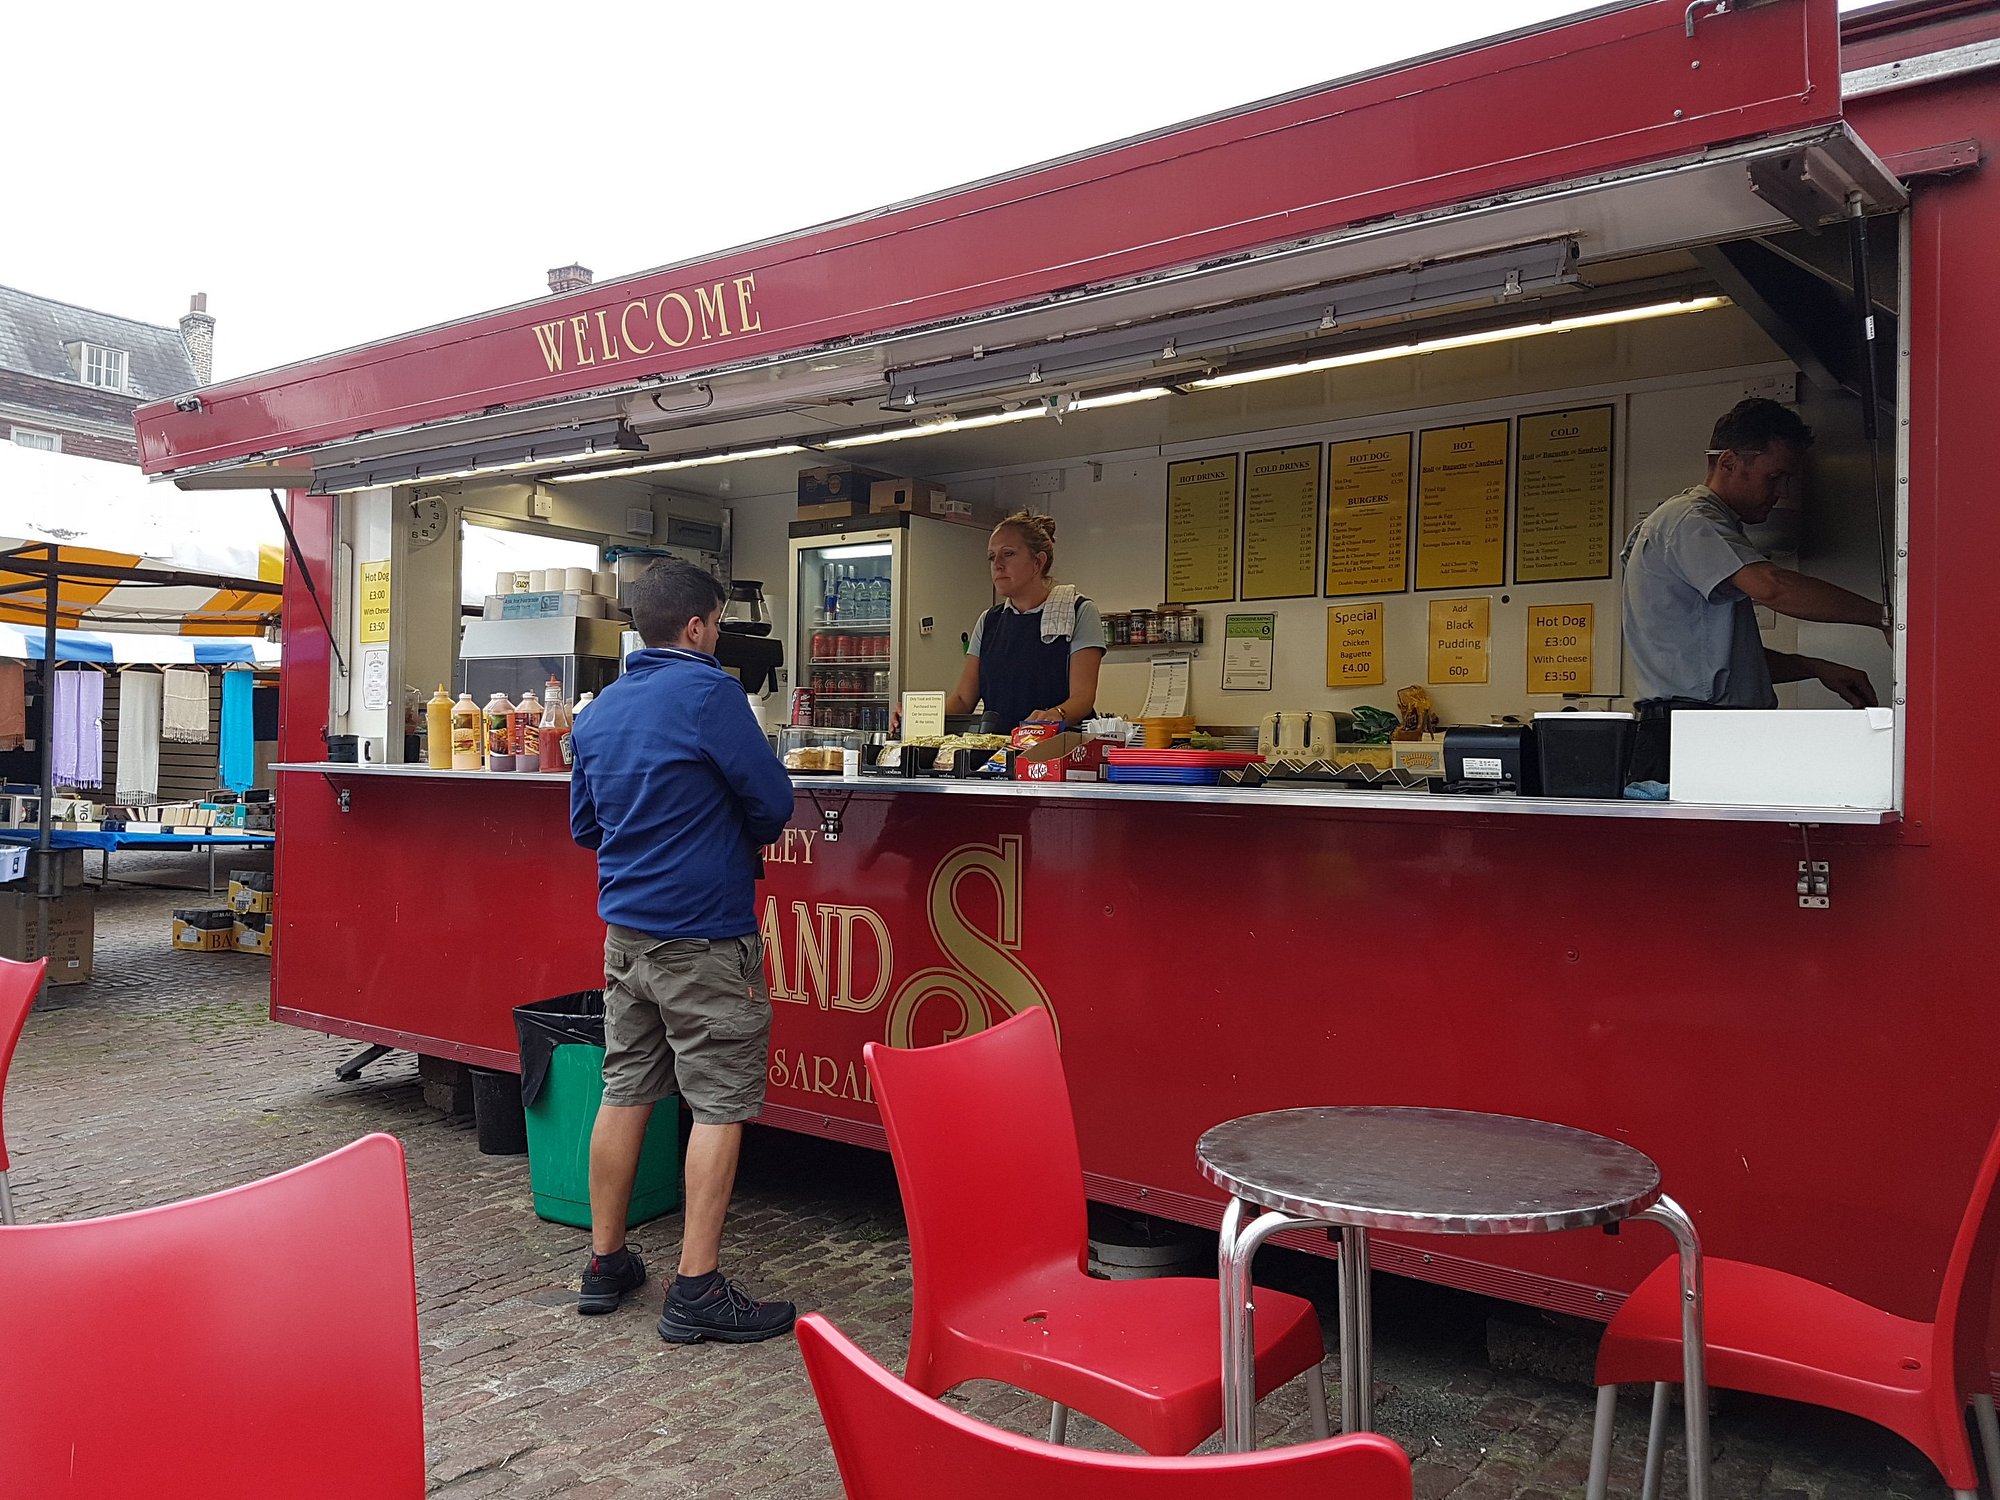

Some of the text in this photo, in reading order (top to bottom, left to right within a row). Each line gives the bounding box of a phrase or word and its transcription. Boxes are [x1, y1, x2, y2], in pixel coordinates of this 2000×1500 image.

[531, 272, 763, 373] WELCOME
[1550, 427, 1579, 437] COLD
[1453, 441, 1474, 450] HOT
[1578, 446, 1608, 455] Sandwich
[1350, 451, 1390, 464] HOT DOG
[1255, 460, 1311, 474] COLD DRINKS
[1442, 463, 1467, 471] Baguette
[1475, 458, 1504, 467] Sandwich
[1180, 470, 1225, 483] HOT DRINKS
[429, 500, 437, 508] 2
[1347, 494, 1389, 506] BURGERS
[433, 512, 440, 520] 3
[429, 522, 436, 530] 4
[411, 531, 419, 539] 6
[421, 529, 429, 538] 5
[365, 571, 390, 582] Hot Dog
[364, 607, 390, 615] With Cheese
[1452, 605, 1468, 613] Add
[1335, 608, 1377, 625] Special
[1536, 615, 1586, 628] Hot Dog
[1446, 619, 1474, 631] Black
[1347, 628, 1366, 637] Spicy
[1342, 639, 1370, 648] Chicken
[1438, 638, 1481, 650] Pudding
[1544, 636, 1577, 647] £3:00
[1340, 651, 1372, 660] Baguette
[1533, 655, 1588, 664] With Cheese
[1342, 662, 1370, 673] £4.00
[1449, 665, 1469, 678] 60p
[1544, 671, 1577, 682] £3:50
[1018, 728, 1046, 737] WALKERS
[80, 803, 89, 821] VIG
[762, 828, 818, 865] LEY
[760, 895, 894, 1014] AND
